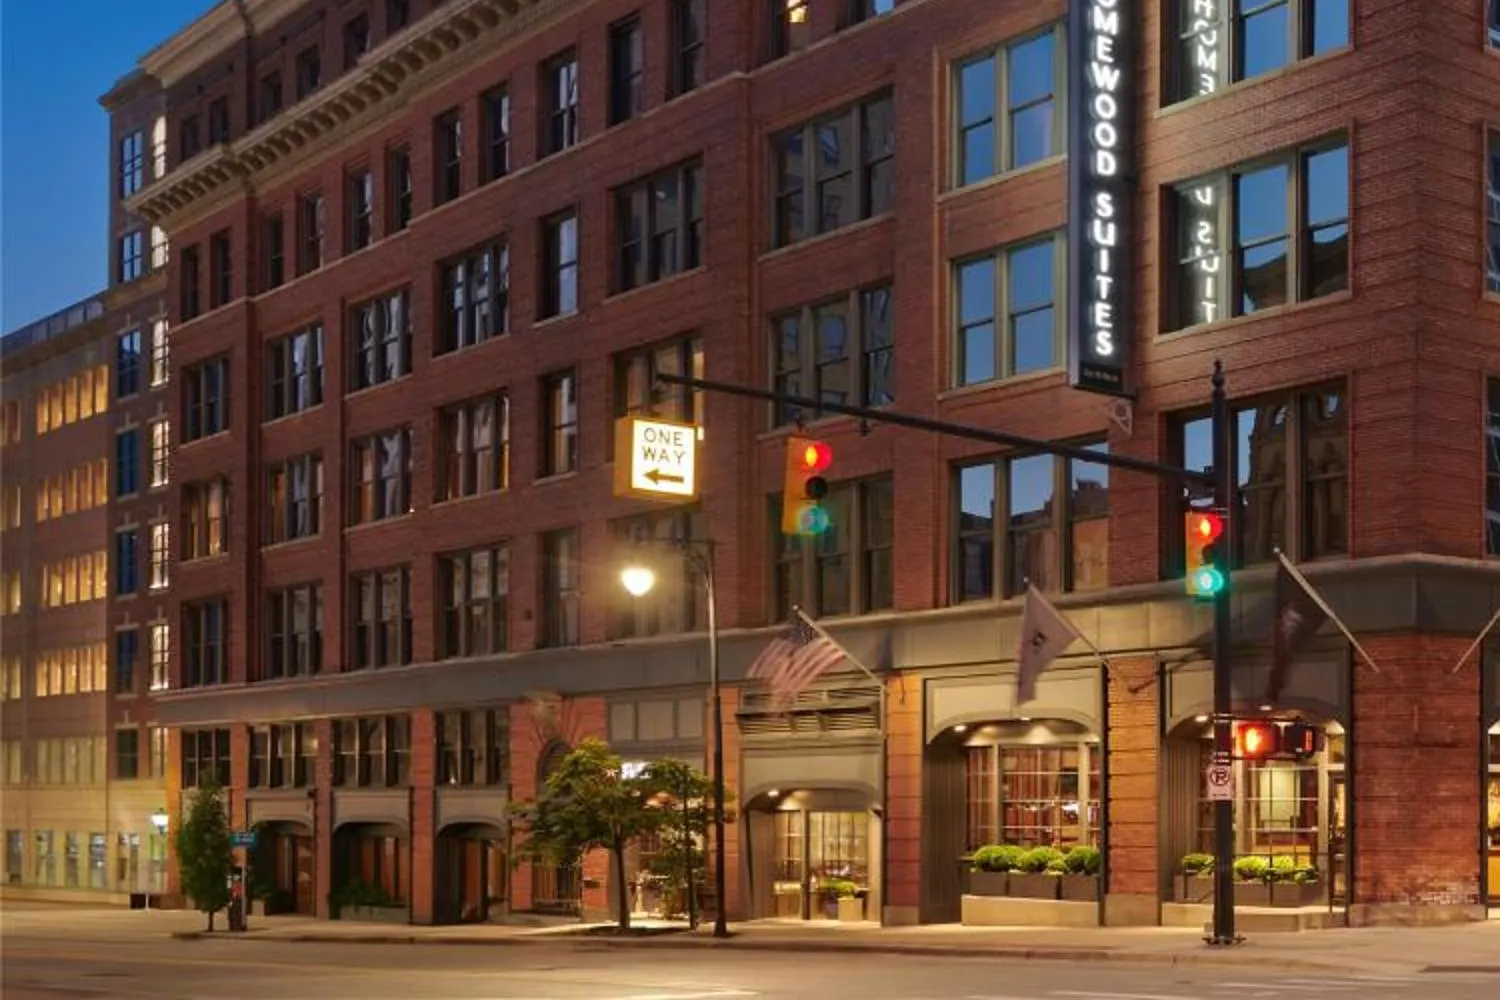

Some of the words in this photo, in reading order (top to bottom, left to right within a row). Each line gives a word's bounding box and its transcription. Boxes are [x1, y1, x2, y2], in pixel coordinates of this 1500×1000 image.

[1093, 192, 1117, 356] SUITES
[643, 427, 684, 447] ONE
[643, 447, 686, 464] WAY
